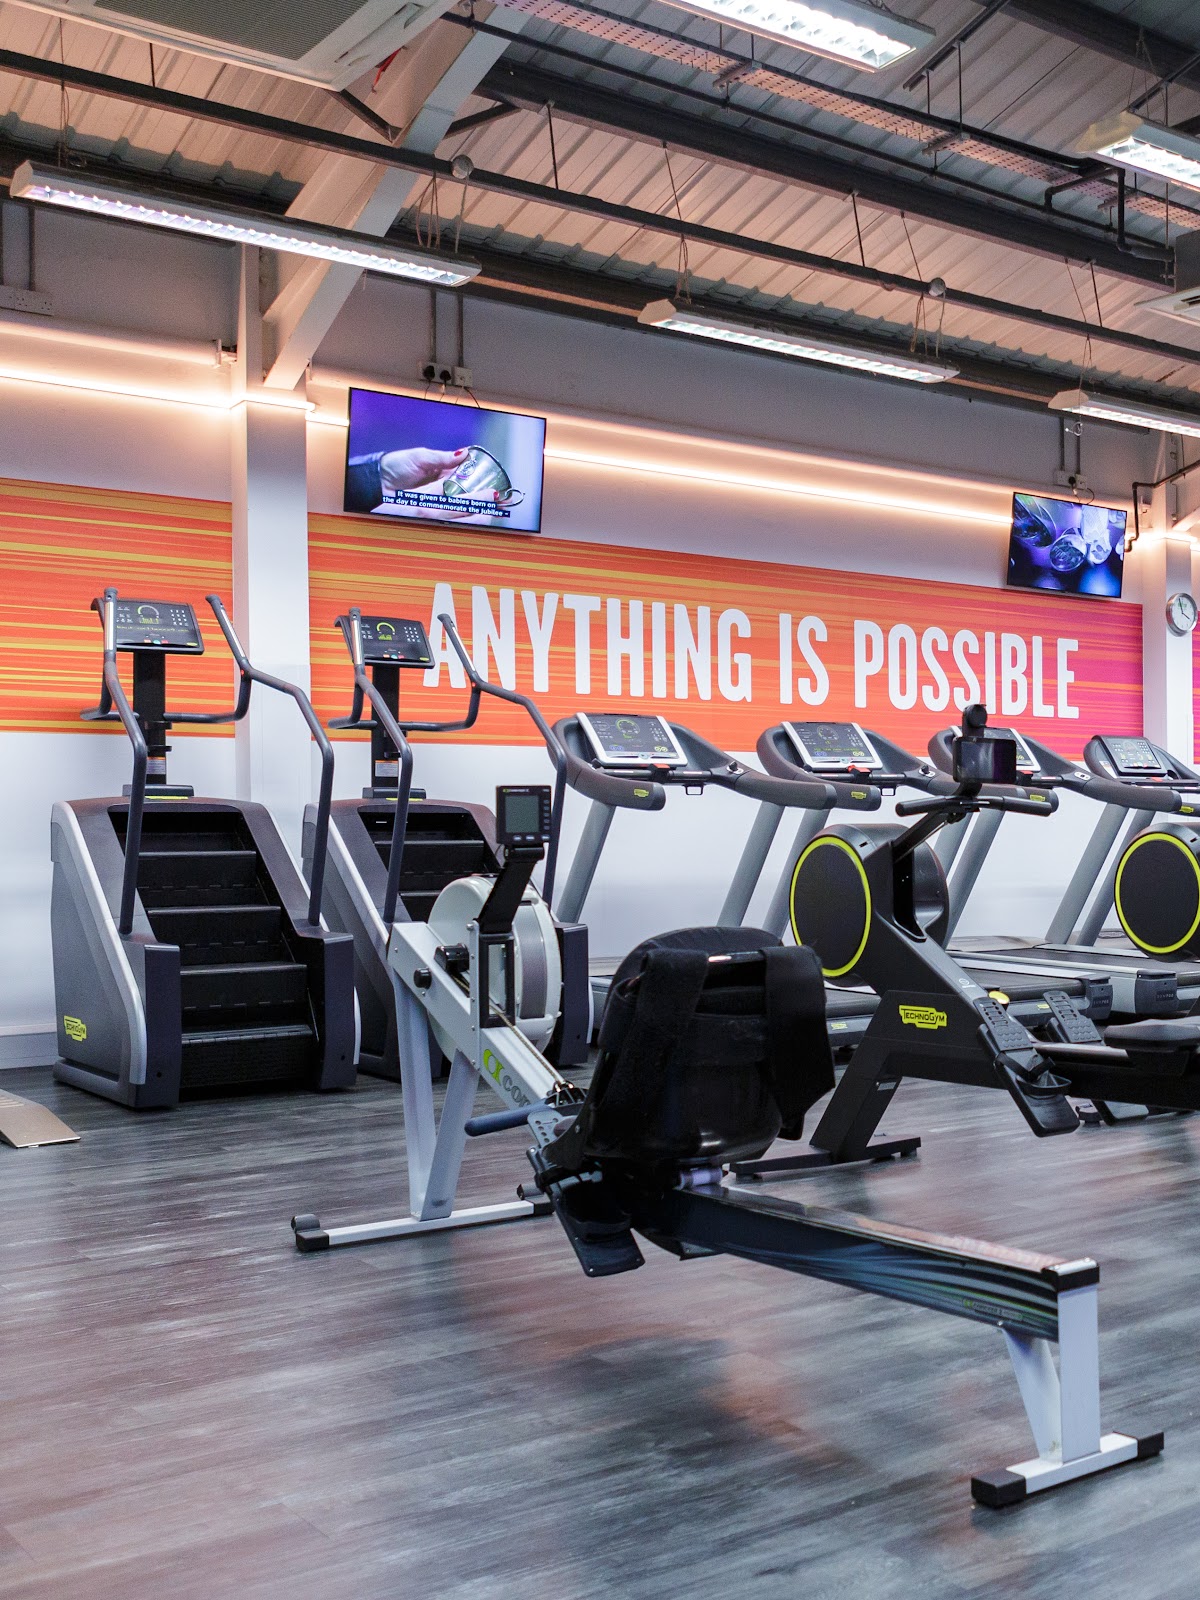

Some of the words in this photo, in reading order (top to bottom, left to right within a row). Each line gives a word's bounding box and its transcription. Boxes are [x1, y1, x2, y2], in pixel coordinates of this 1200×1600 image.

[396, 498, 409, 506] day
[418, 502, 467, 512] commemorate
[419, 493, 438, 501] given
[447, 496, 470, 505] babies
[423, 582, 752, 703] ANYTHING
[779, 613, 828, 706] IS
[854, 619, 1080, 720] POSSIBLE
[901, 1008, 945, 1024] TECHNOGYM
